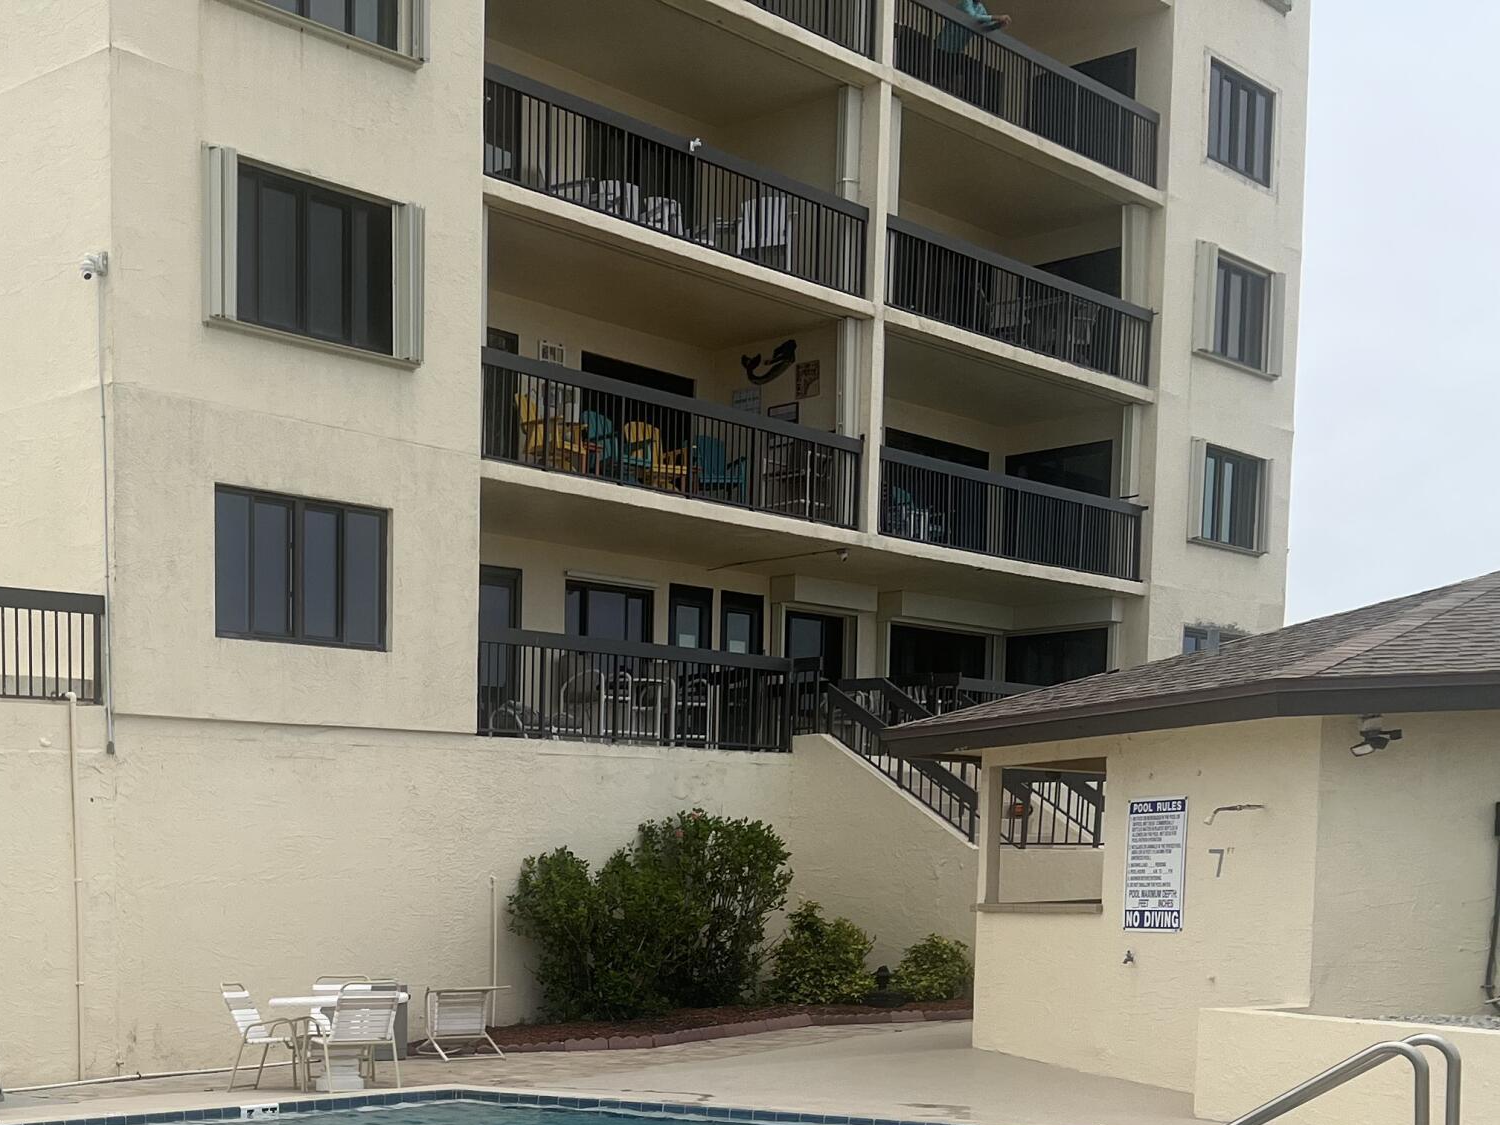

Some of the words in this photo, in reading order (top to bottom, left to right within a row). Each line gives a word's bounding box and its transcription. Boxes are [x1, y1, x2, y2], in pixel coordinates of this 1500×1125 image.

[1132, 803, 1153, 813] POOL
[1156, 800, 1182, 812] RULES
[1208, 848, 1225, 878] 7
[1126, 911, 1140, 927] NO
[1144, 911, 1179, 928] DIVING
